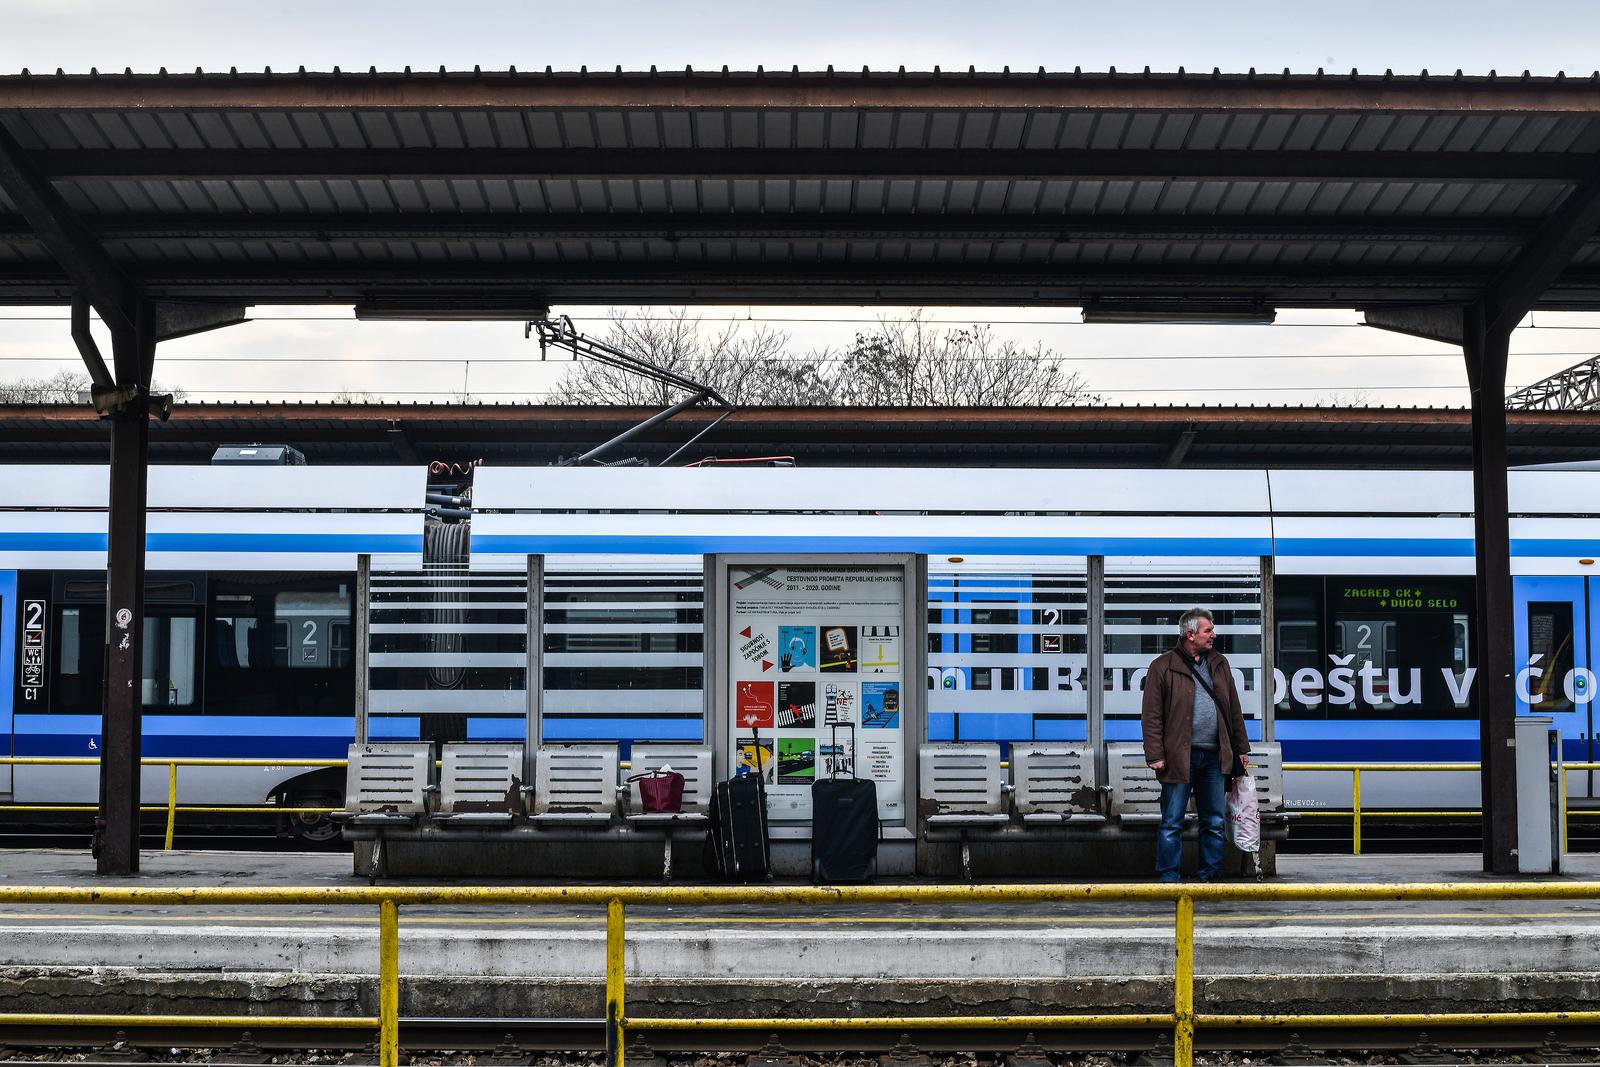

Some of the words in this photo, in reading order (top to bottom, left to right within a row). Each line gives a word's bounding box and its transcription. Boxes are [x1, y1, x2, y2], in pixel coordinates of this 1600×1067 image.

[1344, 589, 1390, 598] ZAGREB
[1391, 600, 1422, 608] DUGO
[1427, 600, 1457, 608] SELO
[27, 603, 42, 629] 2
[303, 620, 317, 645] 2
[1357, 624, 1372, 649] 2
[740, 633, 765, 653] SIGURNOST
[751, 649, 769, 663] TOBOM
[25, 688, 37, 700] C1
